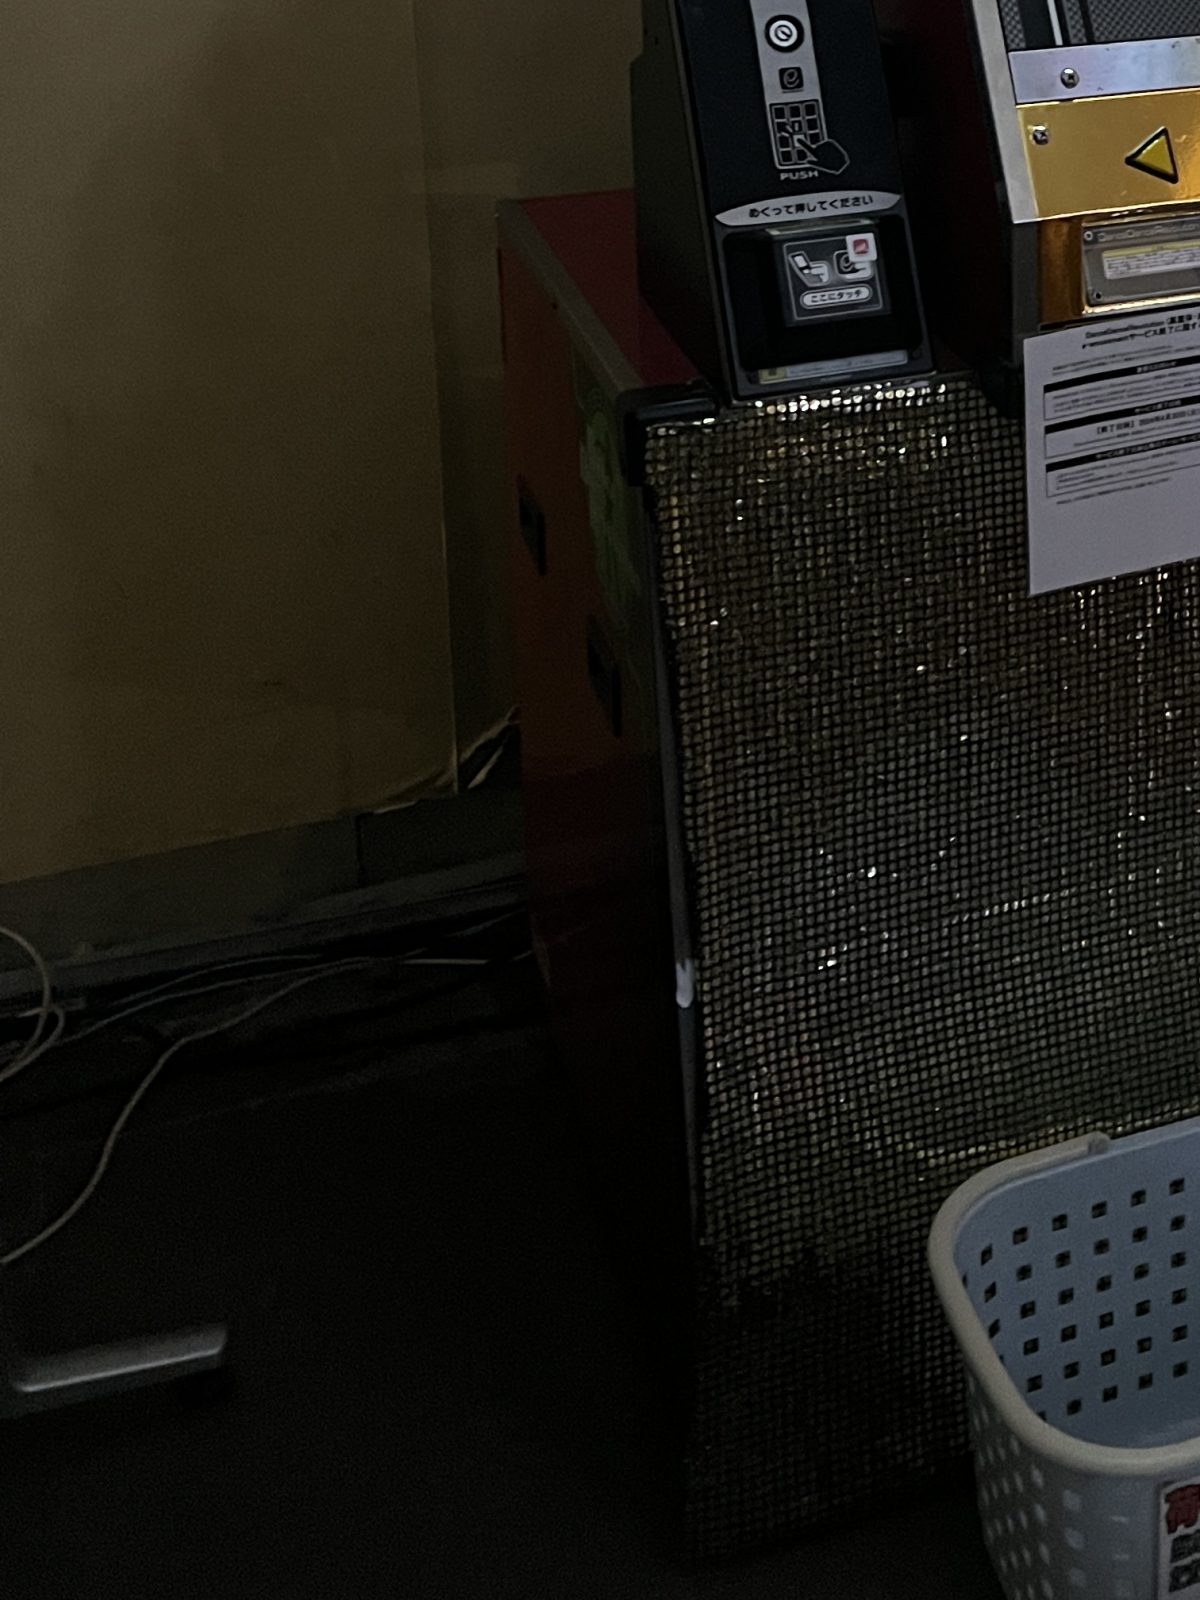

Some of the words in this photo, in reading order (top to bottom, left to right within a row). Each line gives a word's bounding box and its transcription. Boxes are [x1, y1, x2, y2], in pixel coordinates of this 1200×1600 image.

[779, 170, 820, 181] PUSH
[748, 194, 875, 219] めくって押してください
[809, 288, 864, 303] ここにタッチ
